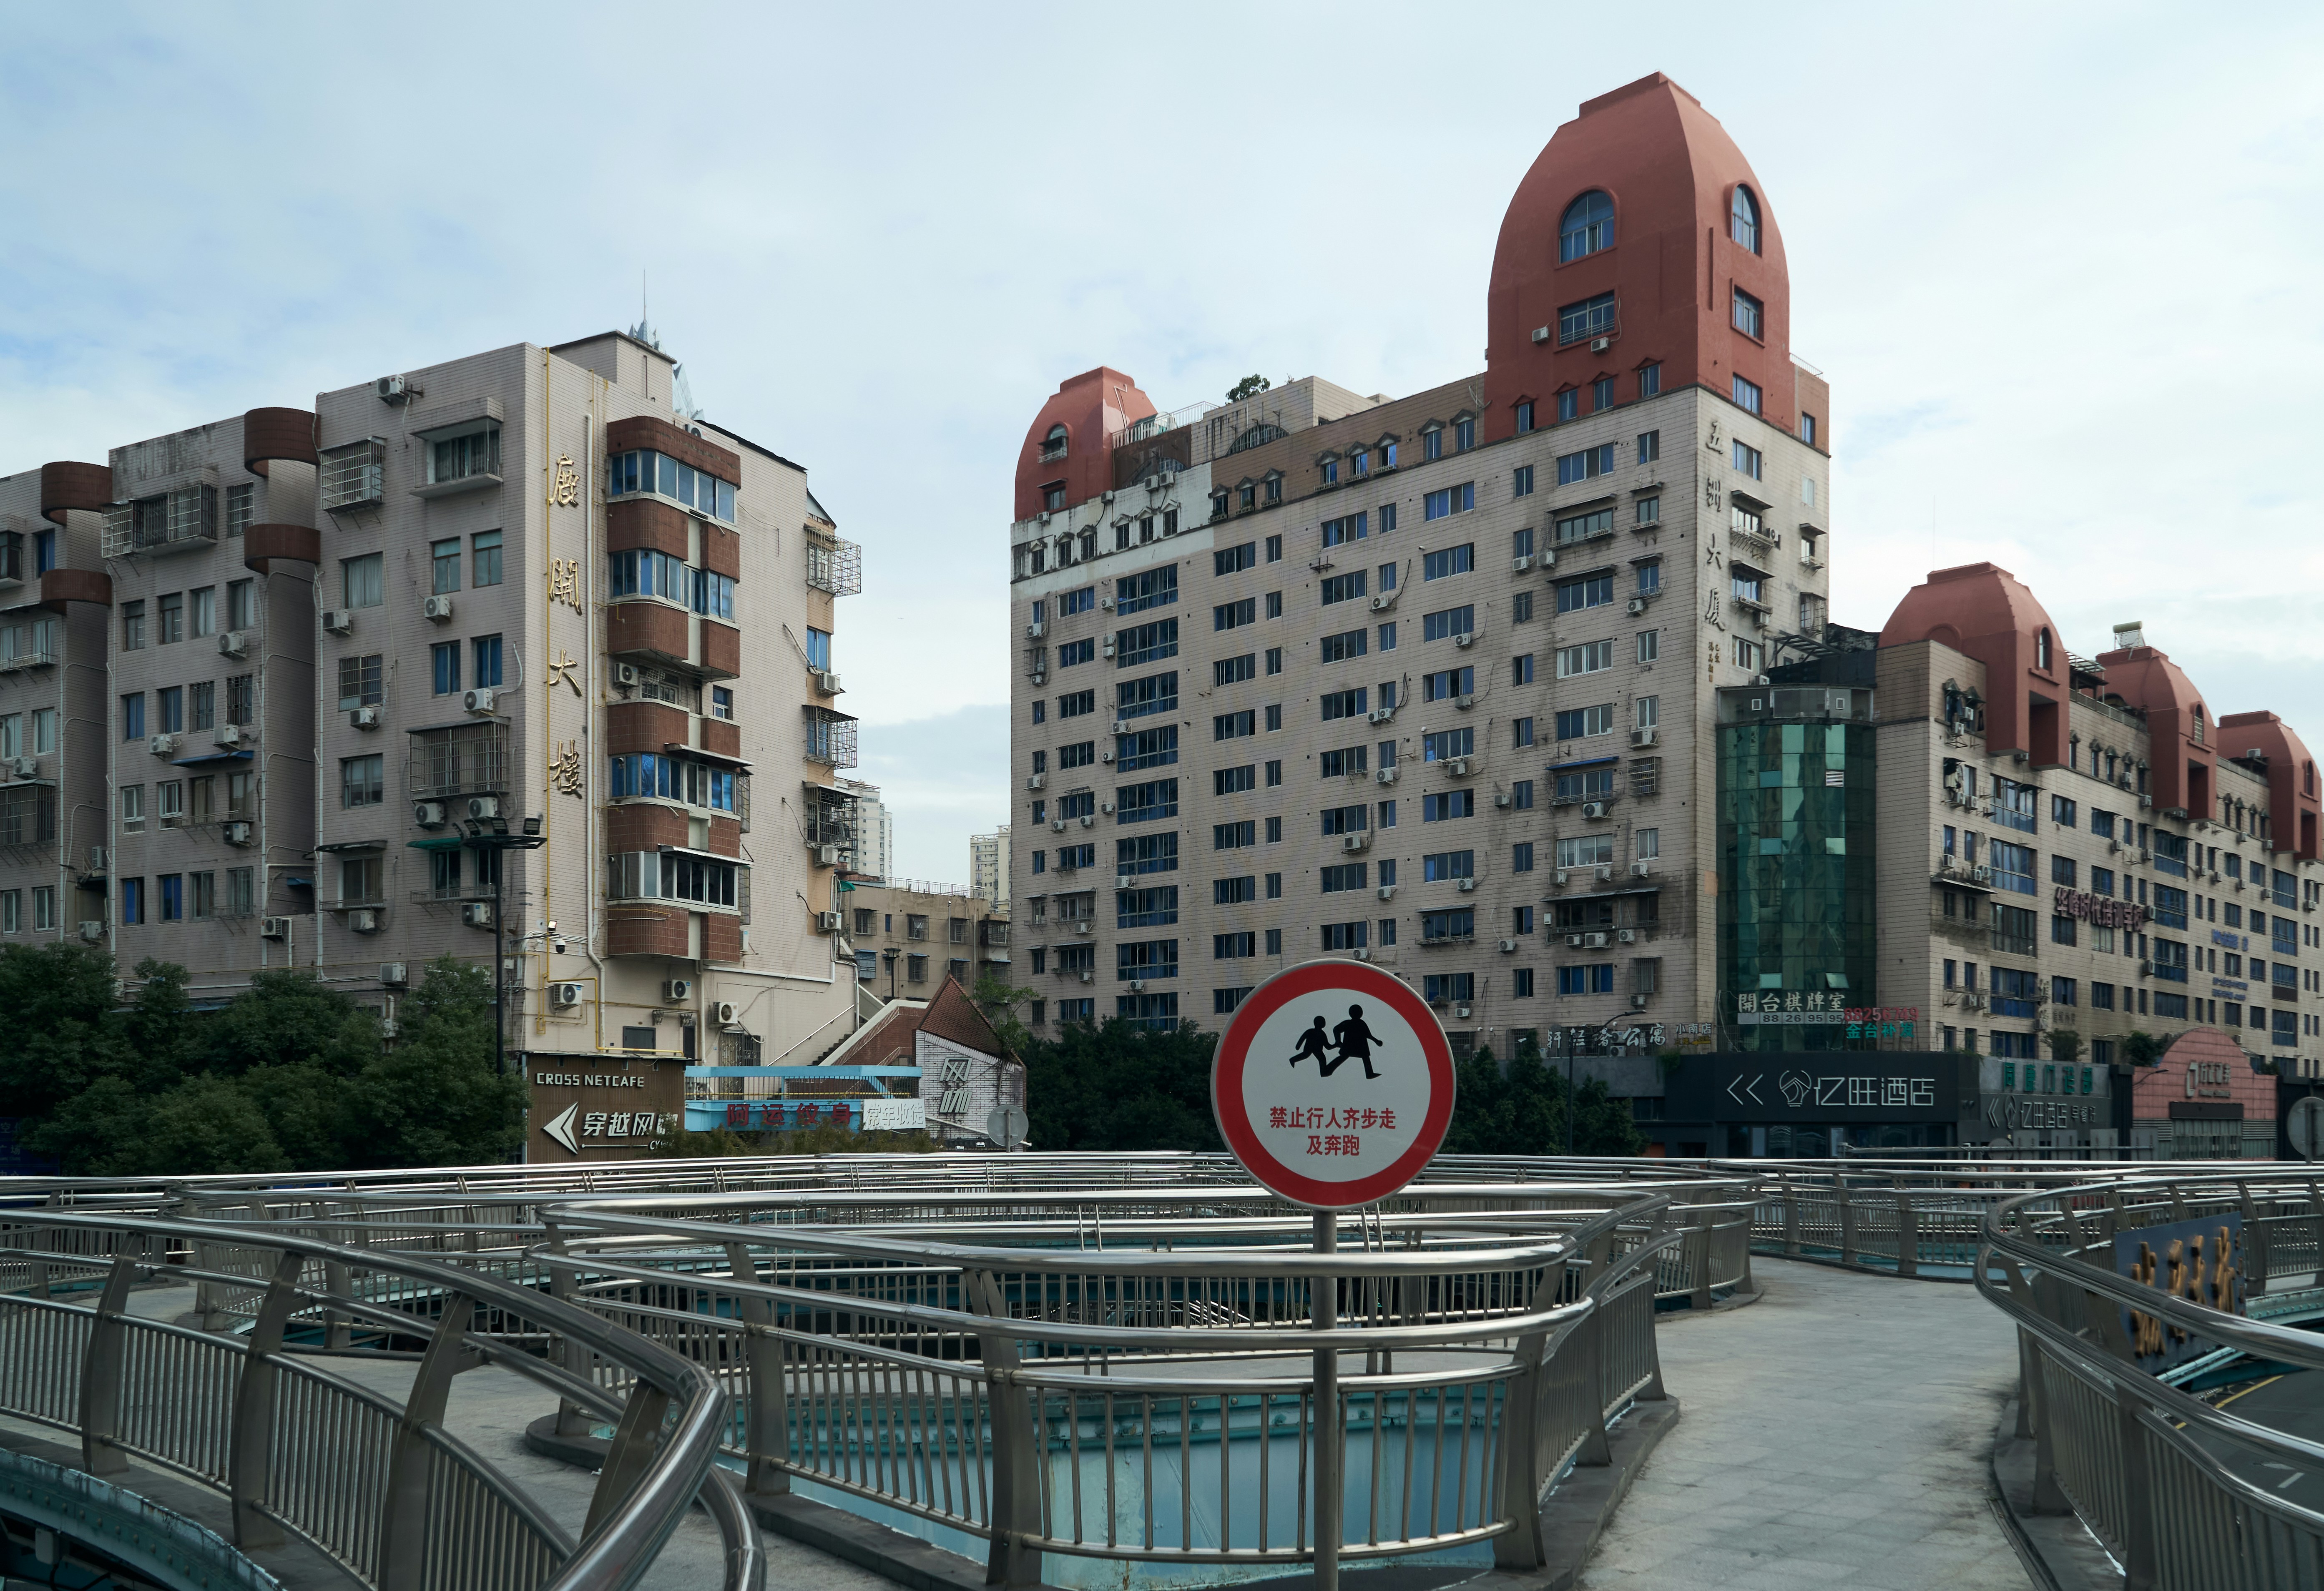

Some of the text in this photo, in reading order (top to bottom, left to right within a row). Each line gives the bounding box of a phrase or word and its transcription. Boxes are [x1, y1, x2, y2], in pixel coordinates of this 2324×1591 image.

[1738, 991, 1845, 1013] 開台棋牌室
[1844, 1007, 1919, 1021] 88256749
[1675, 1023, 1712, 1034] 小南店
[536, 1073, 644, 1087] CROSS NETCAFE
[940, 1057, 973, 1113] 网咖
[1814, 1077, 1935, 1107] 亿旺酒店
[727, 1102, 853, 1126] 阿运纹身
[864, 1102, 924, 1126] 常年收徒
[1270, 1107, 1396, 1129] 禁止行人齐步走
[2020, 1102, 2067, 1128] 亿旺酒店
[1306, 1135, 1360, 1156] 及奔跑
